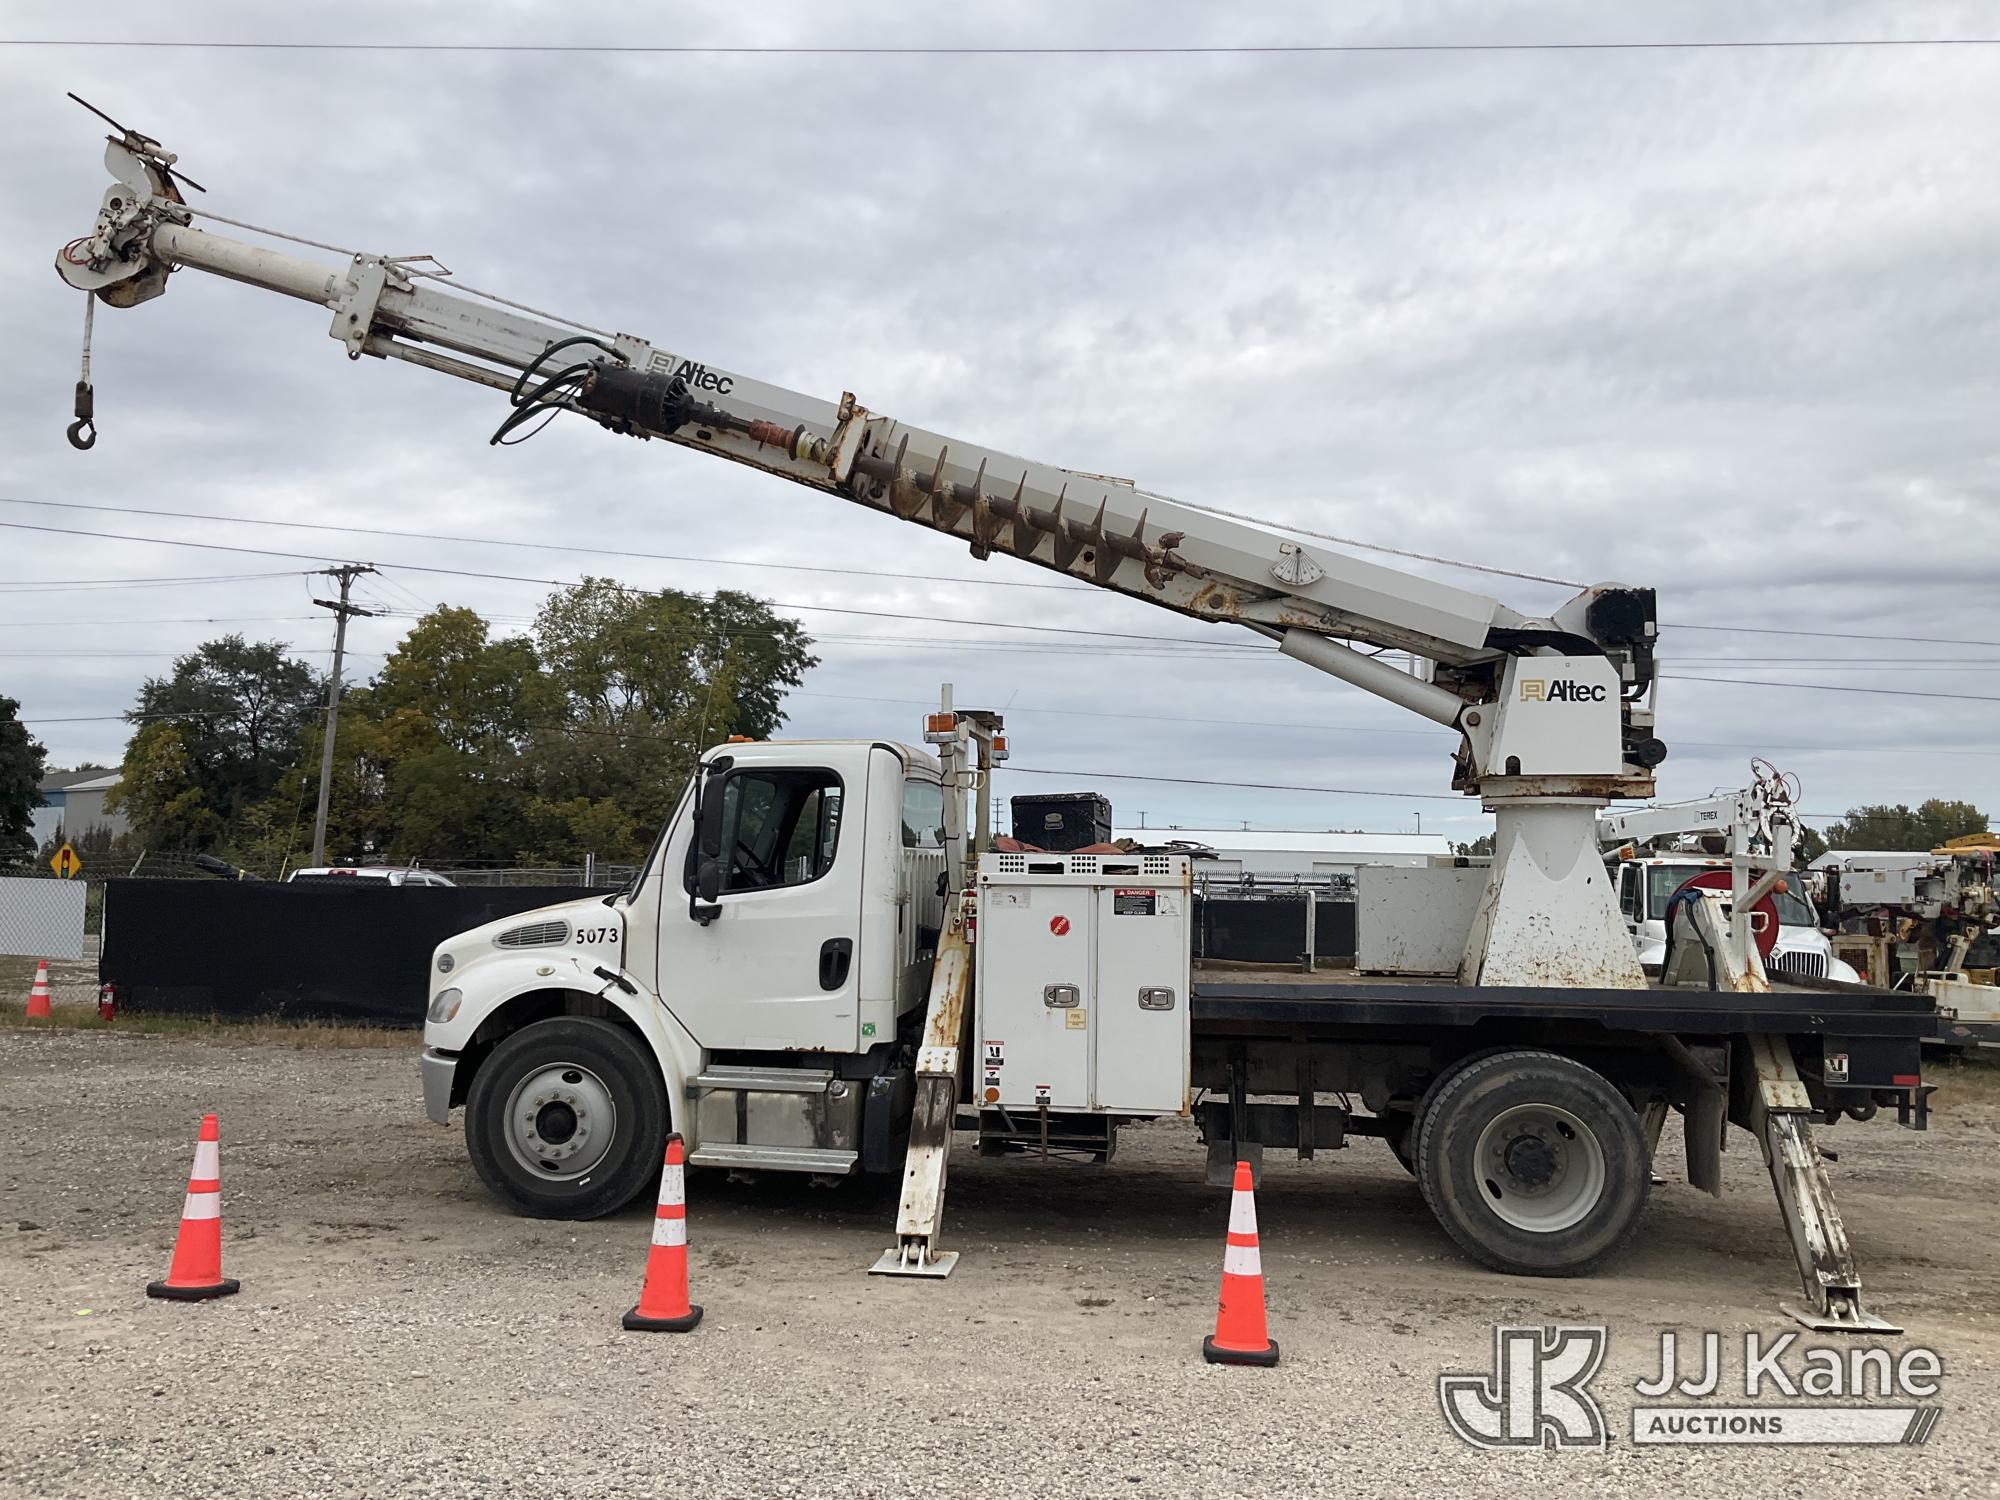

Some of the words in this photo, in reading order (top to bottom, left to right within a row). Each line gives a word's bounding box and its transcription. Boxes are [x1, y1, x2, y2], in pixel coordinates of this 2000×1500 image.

[672, 359, 734, 395] Altec
[1546, 679, 1607, 702] Altec
[1700, 811, 1718, 820] TEREX
[576, 928, 618, 944] 5073
